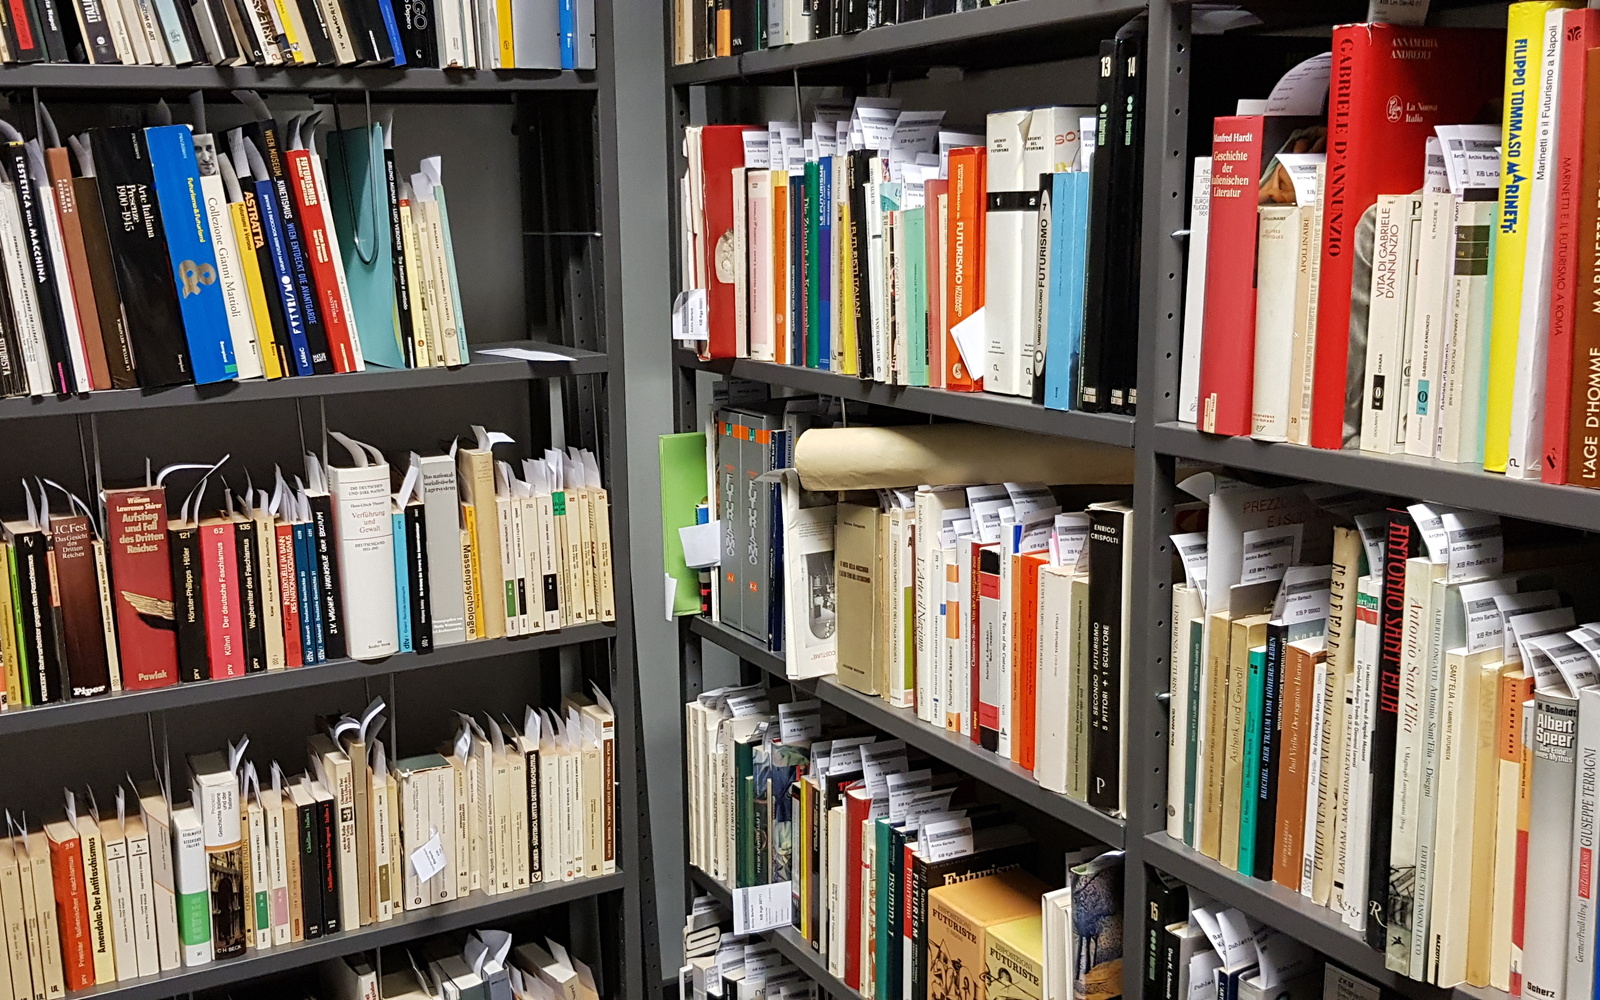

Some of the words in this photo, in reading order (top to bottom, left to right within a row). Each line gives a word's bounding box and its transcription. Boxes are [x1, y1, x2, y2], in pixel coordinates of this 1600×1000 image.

[1547, 25, 1557, 52] Napoli
[1101, 56, 1111, 77] 13
[1127, 56, 1136, 77] 14
[1390, 50, 1432, 59] ANDREOLI
[1512, 38, 1528, 87] FILIPPO
[1336, 38, 1354, 134] GABRIELE
[1542, 72, 1553, 119] Futurismo
[1405, 112, 1423, 123] Italia
[1406, 102, 1415, 111] La
[1234, 133, 1252, 142] Hardt
[1508, 90, 1525, 158] TOMMASO
[1542, 119, 1549, 128] il
[1214, 152, 1248, 161] Geschichte
[1222, 163, 1233, 173] der
[1537, 138, 1548, 180] Marinetti
[138, 184, 147, 204] Arte
[300, 157, 318, 206] FUTURISMUS
[1214, 188, 1241, 197] Literatur
[1562, 157, 1572, 211] MARINETTI
[116, 185, 135, 232] 1900-1945
[127, 184, 140, 223] Presenze
[1029, 198, 1036, 206] 2
[1329, 141, 1347, 257] D'ANNUNZIO
[1412, 202, 1421, 215] P
[15, 156, 31, 210] L'ESTETICA
[29, 228, 46, 283] MACCHINA
[142, 204, 155, 238] Italiana
[244, 191, 265, 248] ASTRATTA
[1381, 207, 1391, 262] GABRIELE
[1560, 222, 1568, 230] IL
[208, 197, 224, 246] Collezione
[218, 247, 232, 280] Gianni
[225, 281, 241, 318] Mattioli
[1039, 218, 1049, 288] FUTURISMO
[1300, 216, 1310, 274] APOLLINAIRE
[1379, 264, 1386, 277] DI
[1385, 224, 1399, 299] D'ANNUNZIO
[1557, 232, 1568, 290] FUTURISMO
[1376, 279, 1385, 298] VITA
[1423, 314, 1431, 350] D'ANNUNZIO
[1554, 304, 1563, 336] ROMA
[1421, 350, 1429, 377] GABRIELE
[1585, 347, 1600, 428] D'HOMME
[1582, 436, 1598, 479] L'AGE
[117, 504, 144, 513] Lawrence
[144, 502, 162, 510] Shirer
[122, 512, 159, 523] Aufstieg
[352, 510, 386, 520] Verführung
[66, 533, 88, 542] Gesicht
[119, 535, 133, 544] des
[135, 531, 164, 542] Dritten
[125, 525, 140, 533] und
[143, 522, 157, 531] Fall
[359, 525, 381, 534] Gewalt
[1090, 533, 1119, 545] CRISPOLTI
[1094, 524, 1115, 534] ENRICO
[62, 545, 84, 553] Dritten
[127, 544, 158, 554] Reiches
[218, 541, 227, 583] Faschismus
[243, 538, 252, 581] Faschismus
[462, 545, 475, 635] Massenpsychologie
[917, 557, 926, 594] L'Arte
[220, 584, 228, 614] deutsche
[248, 593, 256, 630] Wegbereiter
[222, 616, 230, 628] Der
[918, 612, 927, 652] Nazismo
[1408, 597, 1423, 658] Antonio
[1434, 607, 1442, 638] ALBERTO
[224, 635, 232, 656] Kühnl
[1268, 637, 1276, 660] LEBEN
[1431, 639, 1440, 681] LONGATTI
[73, 685, 106, 697] Piper
[138, 670, 168, 682] Pawlak
[1233, 666, 1244, 704] Gewalt
[1265, 662, 1275, 699] HÖHEREN
[1449, 664, 1457, 699] SANT'ELIA
[1265, 699, 1273, 717] VOM
[1403, 662, 1422, 734] Sant'Elia
[1429, 684, 1438, 717] Antonio
[1545, 704, 1577, 717] Schmidt
[1092, 720, 1099, 728] IL
[1232, 705, 1241, 726] und
[1263, 718, 1271, 744] TRAUM
[1537, 713, 1574, 733] Albert
[1426, 716, 1437, 757] Sant'Elia
[1536, 730, 1574, 747] Speer
[1550, 752, 1573, 763] Mythos
[1583, 748, 1596, 796] TERRAGNI
[1260, 768, 1269, 800] REICHEL
[1424, 767, 1433, 798] Disegni
[1581, 798, 1594, 848] GIUSEPPE
[88, 837, 101, 896] Antifaschismus
[1338, 830, 1348, 875] BANHAM
[69, 856, 79, 896] Faschismus
[93, 896, 102, 911] Der
[911, 872, 919, 938] FUTURISM
[1150, 901, 1159, 921] 15
[97, 908, 107, 953] Amendola:
[932, 908, 977, 944] FUTURISTE
[990, 946, 1040, 987] FUTURISTE
[1526, 981, 1555, 998] Scherz
